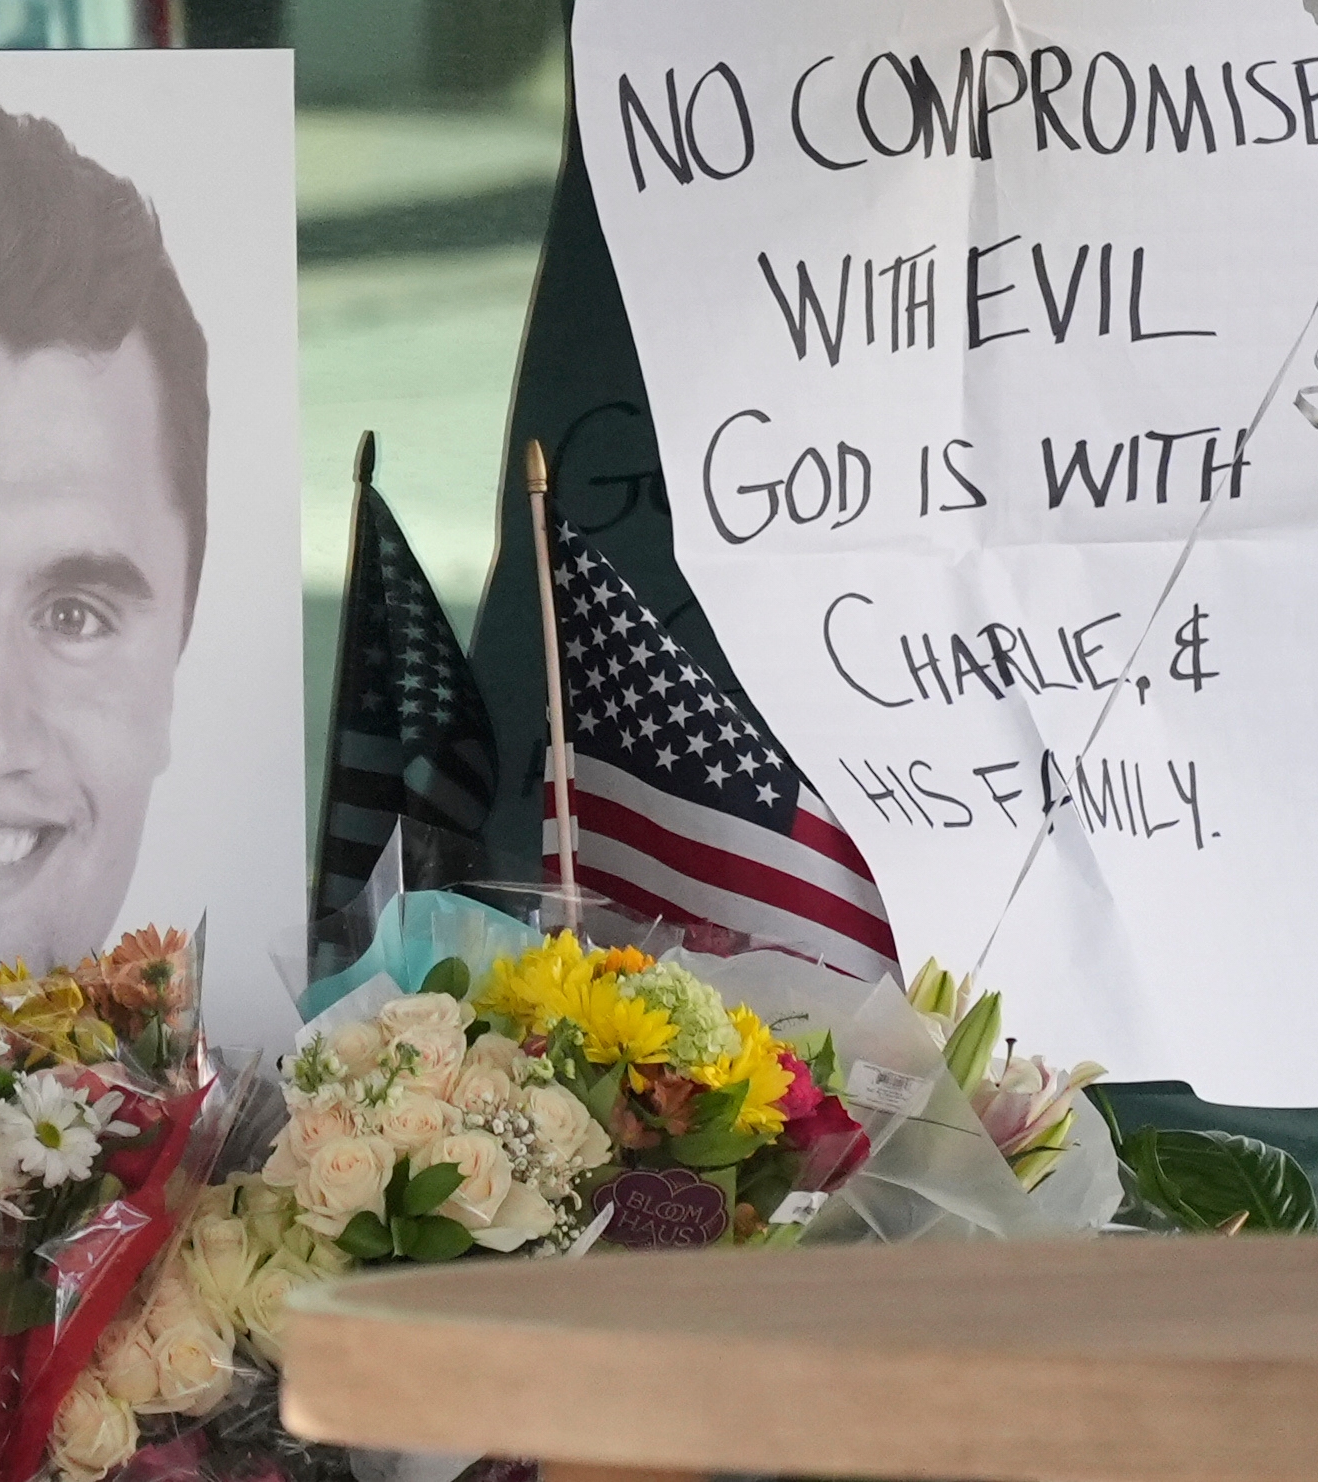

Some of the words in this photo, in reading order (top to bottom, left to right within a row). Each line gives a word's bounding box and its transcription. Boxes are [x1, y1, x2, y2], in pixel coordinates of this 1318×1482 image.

[619, 60, 755, 193] NO
[757, 243, 936, 366] WITH
[965, 233, 1217, 348] EVIL
[703, 410, 870, 544] GOD
[919, 441, 989, 517] IS
[1044, 428, 1251, 509] WITH
[838, 756, 975, 830] HIS
[973, 750, 1222, 850] FAMILY.
[618, 1210, 695, 1247] HAUS
[626, 1190, 704, 1224] BLOOM
